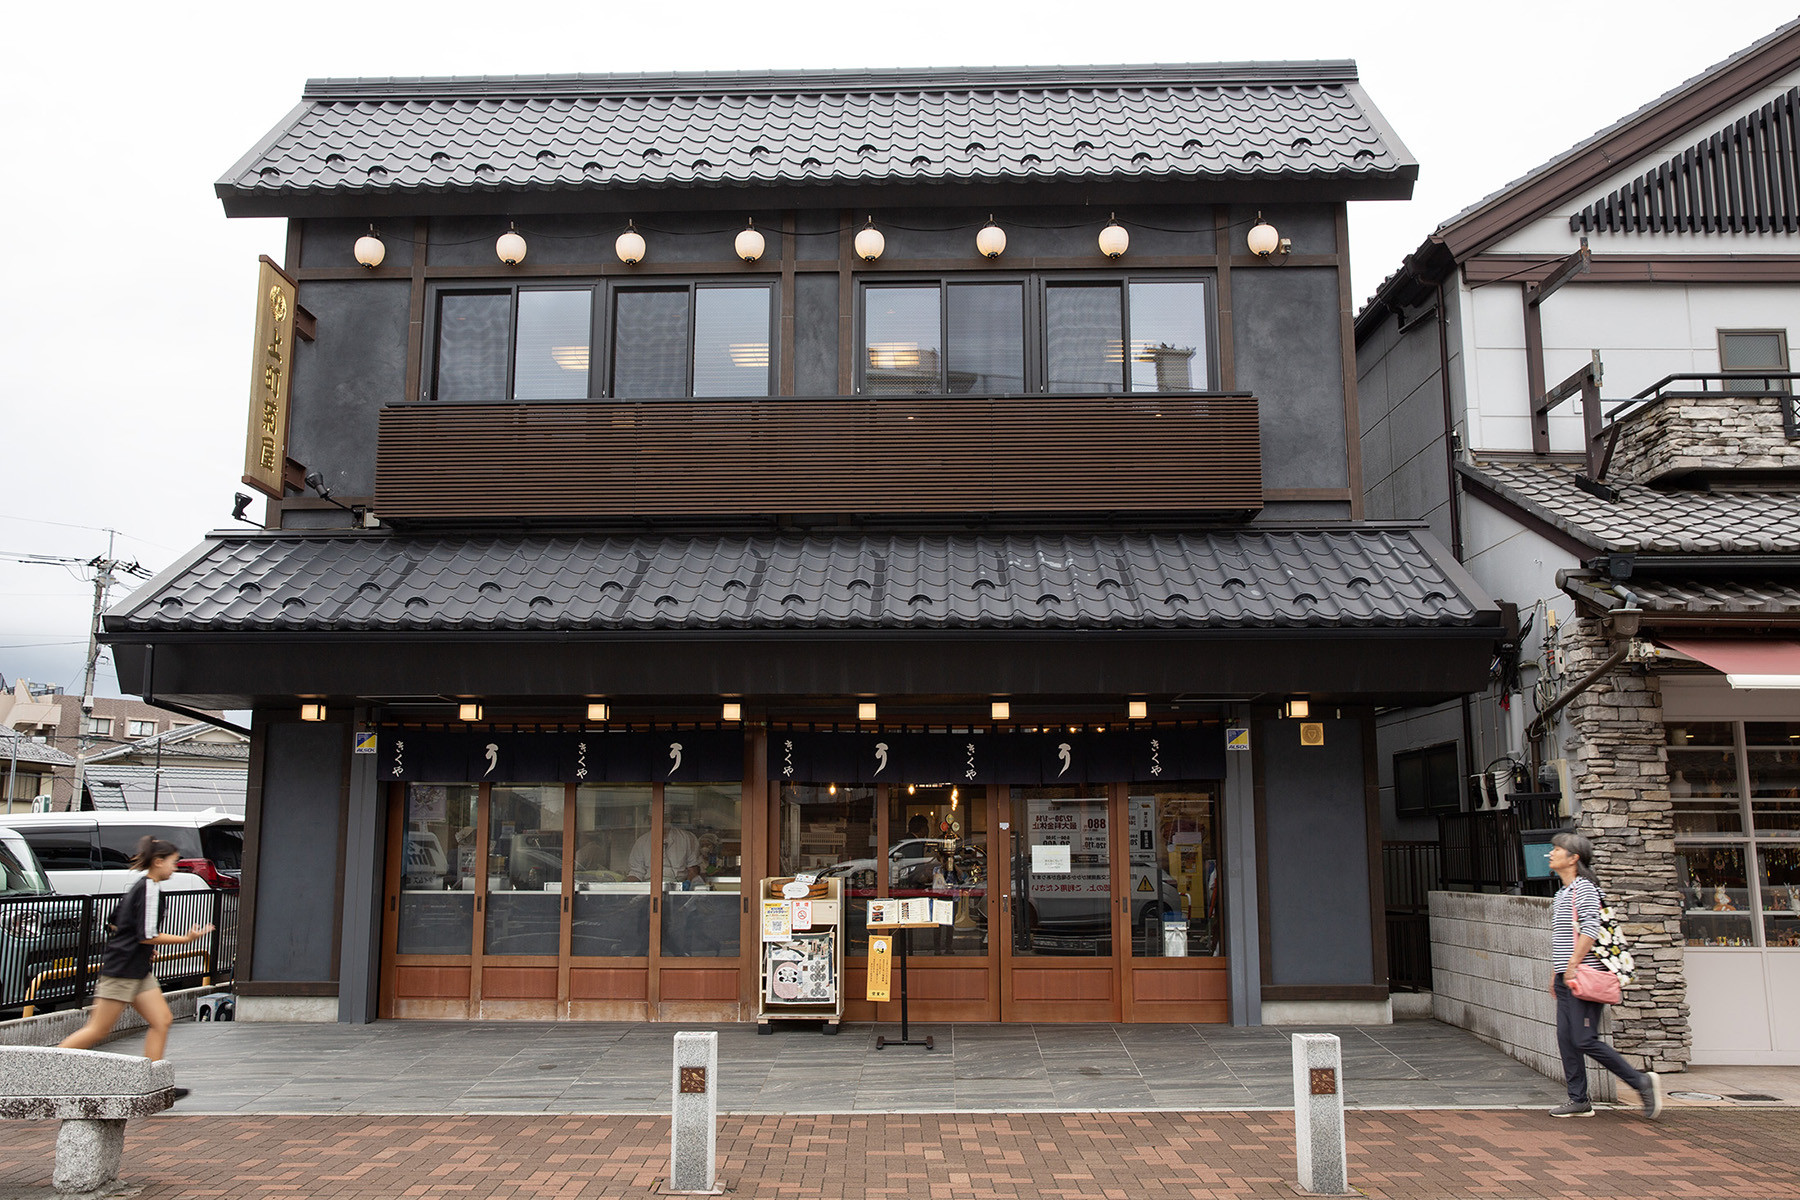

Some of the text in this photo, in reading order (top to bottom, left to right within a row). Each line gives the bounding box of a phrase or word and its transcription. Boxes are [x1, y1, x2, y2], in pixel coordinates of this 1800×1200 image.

[392, 740, 404, 777] きくや
[576, 742, 588, 779] きくや
[783, 740, 794, 777] きくや
[965, 743, 977, 780] きくや
[1150, 739, 1162, 776] きくや
